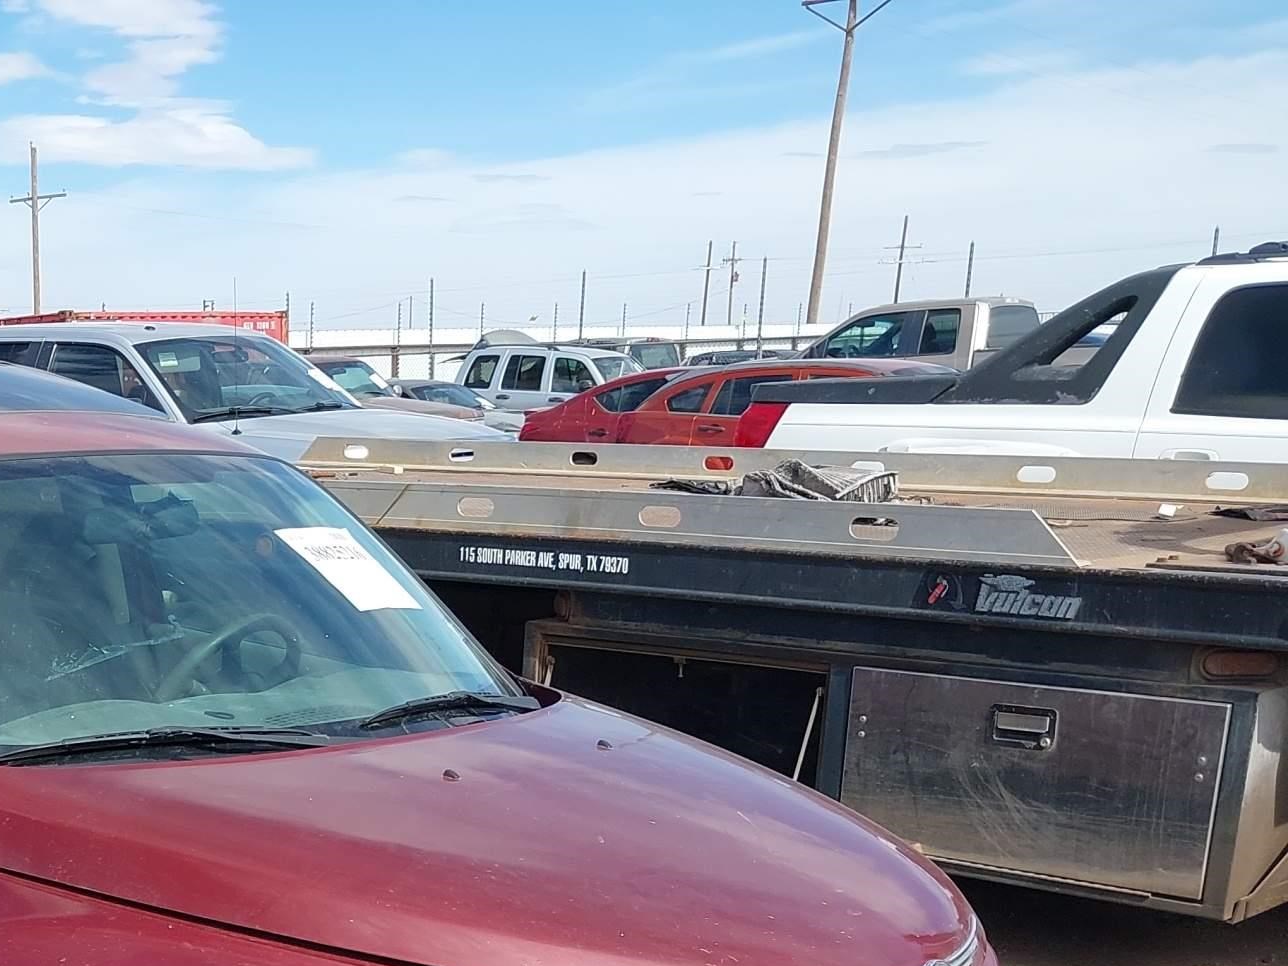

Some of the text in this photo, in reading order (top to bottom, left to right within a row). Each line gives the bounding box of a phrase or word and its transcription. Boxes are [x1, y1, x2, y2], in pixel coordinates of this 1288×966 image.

[460, 546, 629, 574] 115 SOUTH PARKER AVE, SPUR, TX 79370
